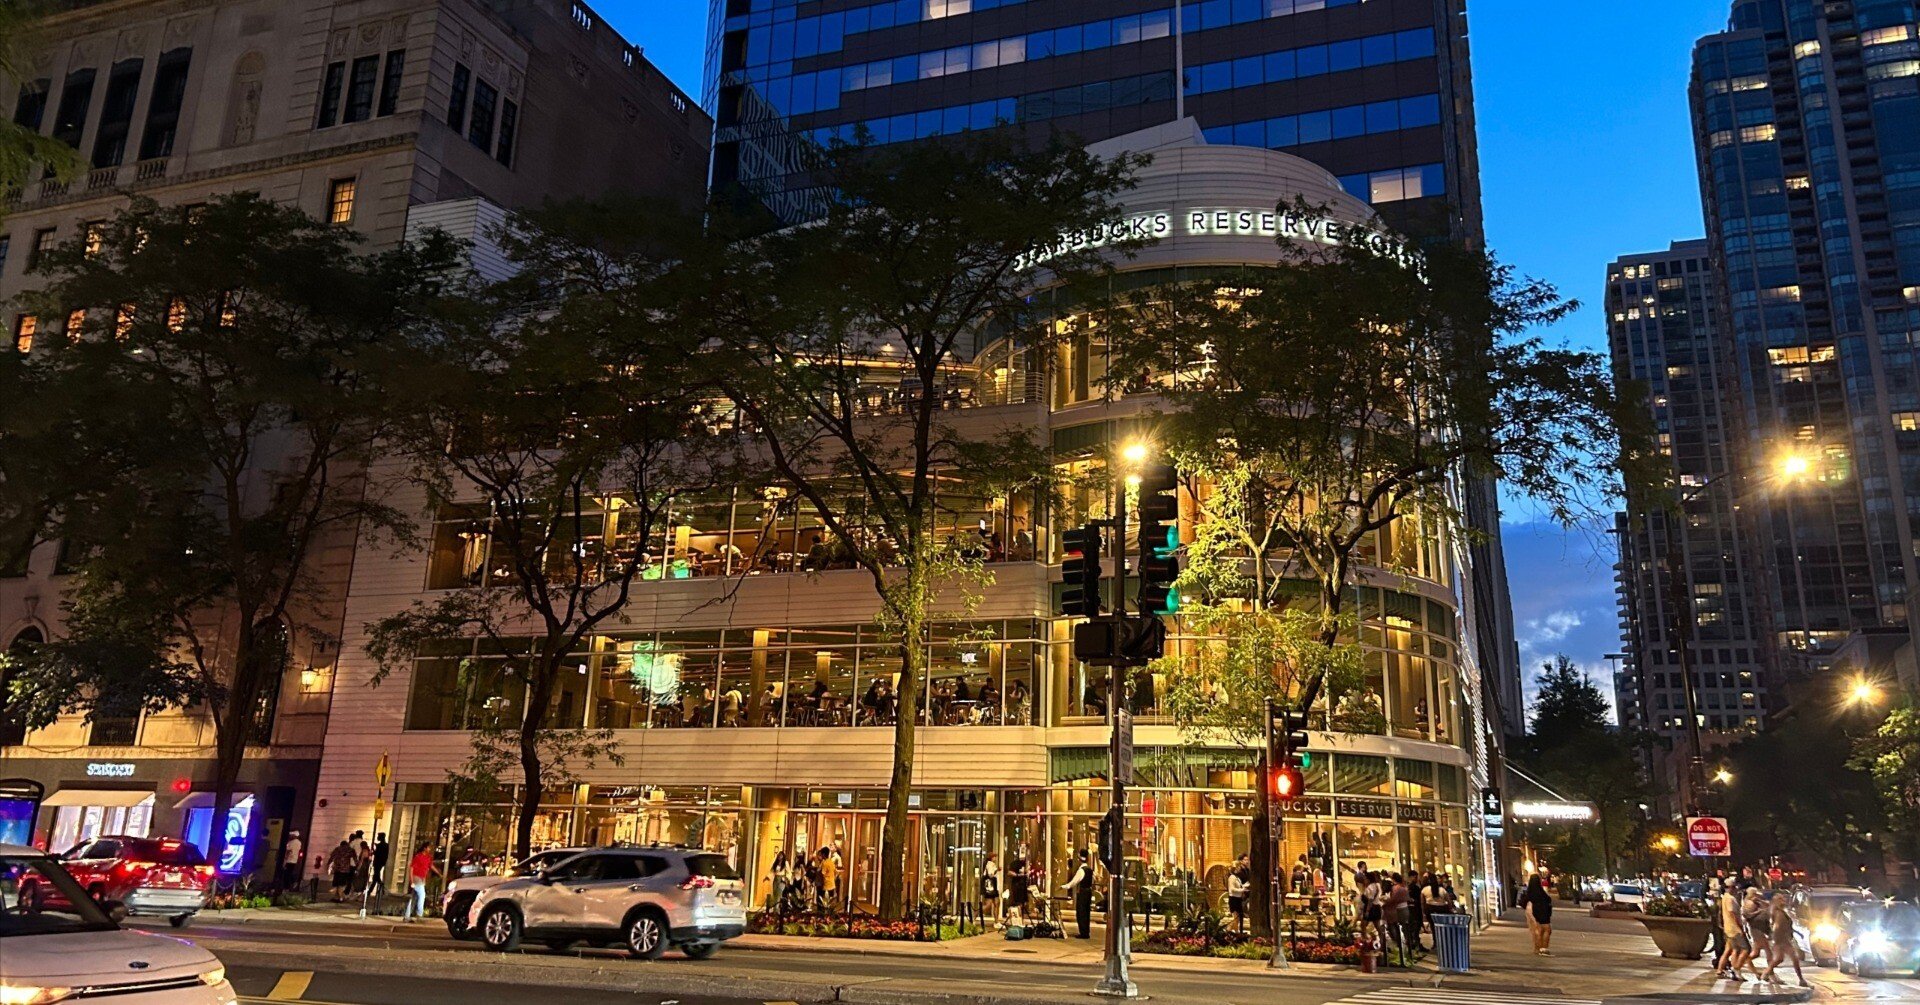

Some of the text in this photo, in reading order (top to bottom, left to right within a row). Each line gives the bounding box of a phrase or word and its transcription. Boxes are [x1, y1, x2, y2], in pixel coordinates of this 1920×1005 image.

[1190, 210, 1341, 241] RESERVE
[1228, 798, 1433, 819] STAUCKS ESERVE ROASTE
[931, 824, 946, 835] 646
[1693, 824, 1721, 832] DO NOT
